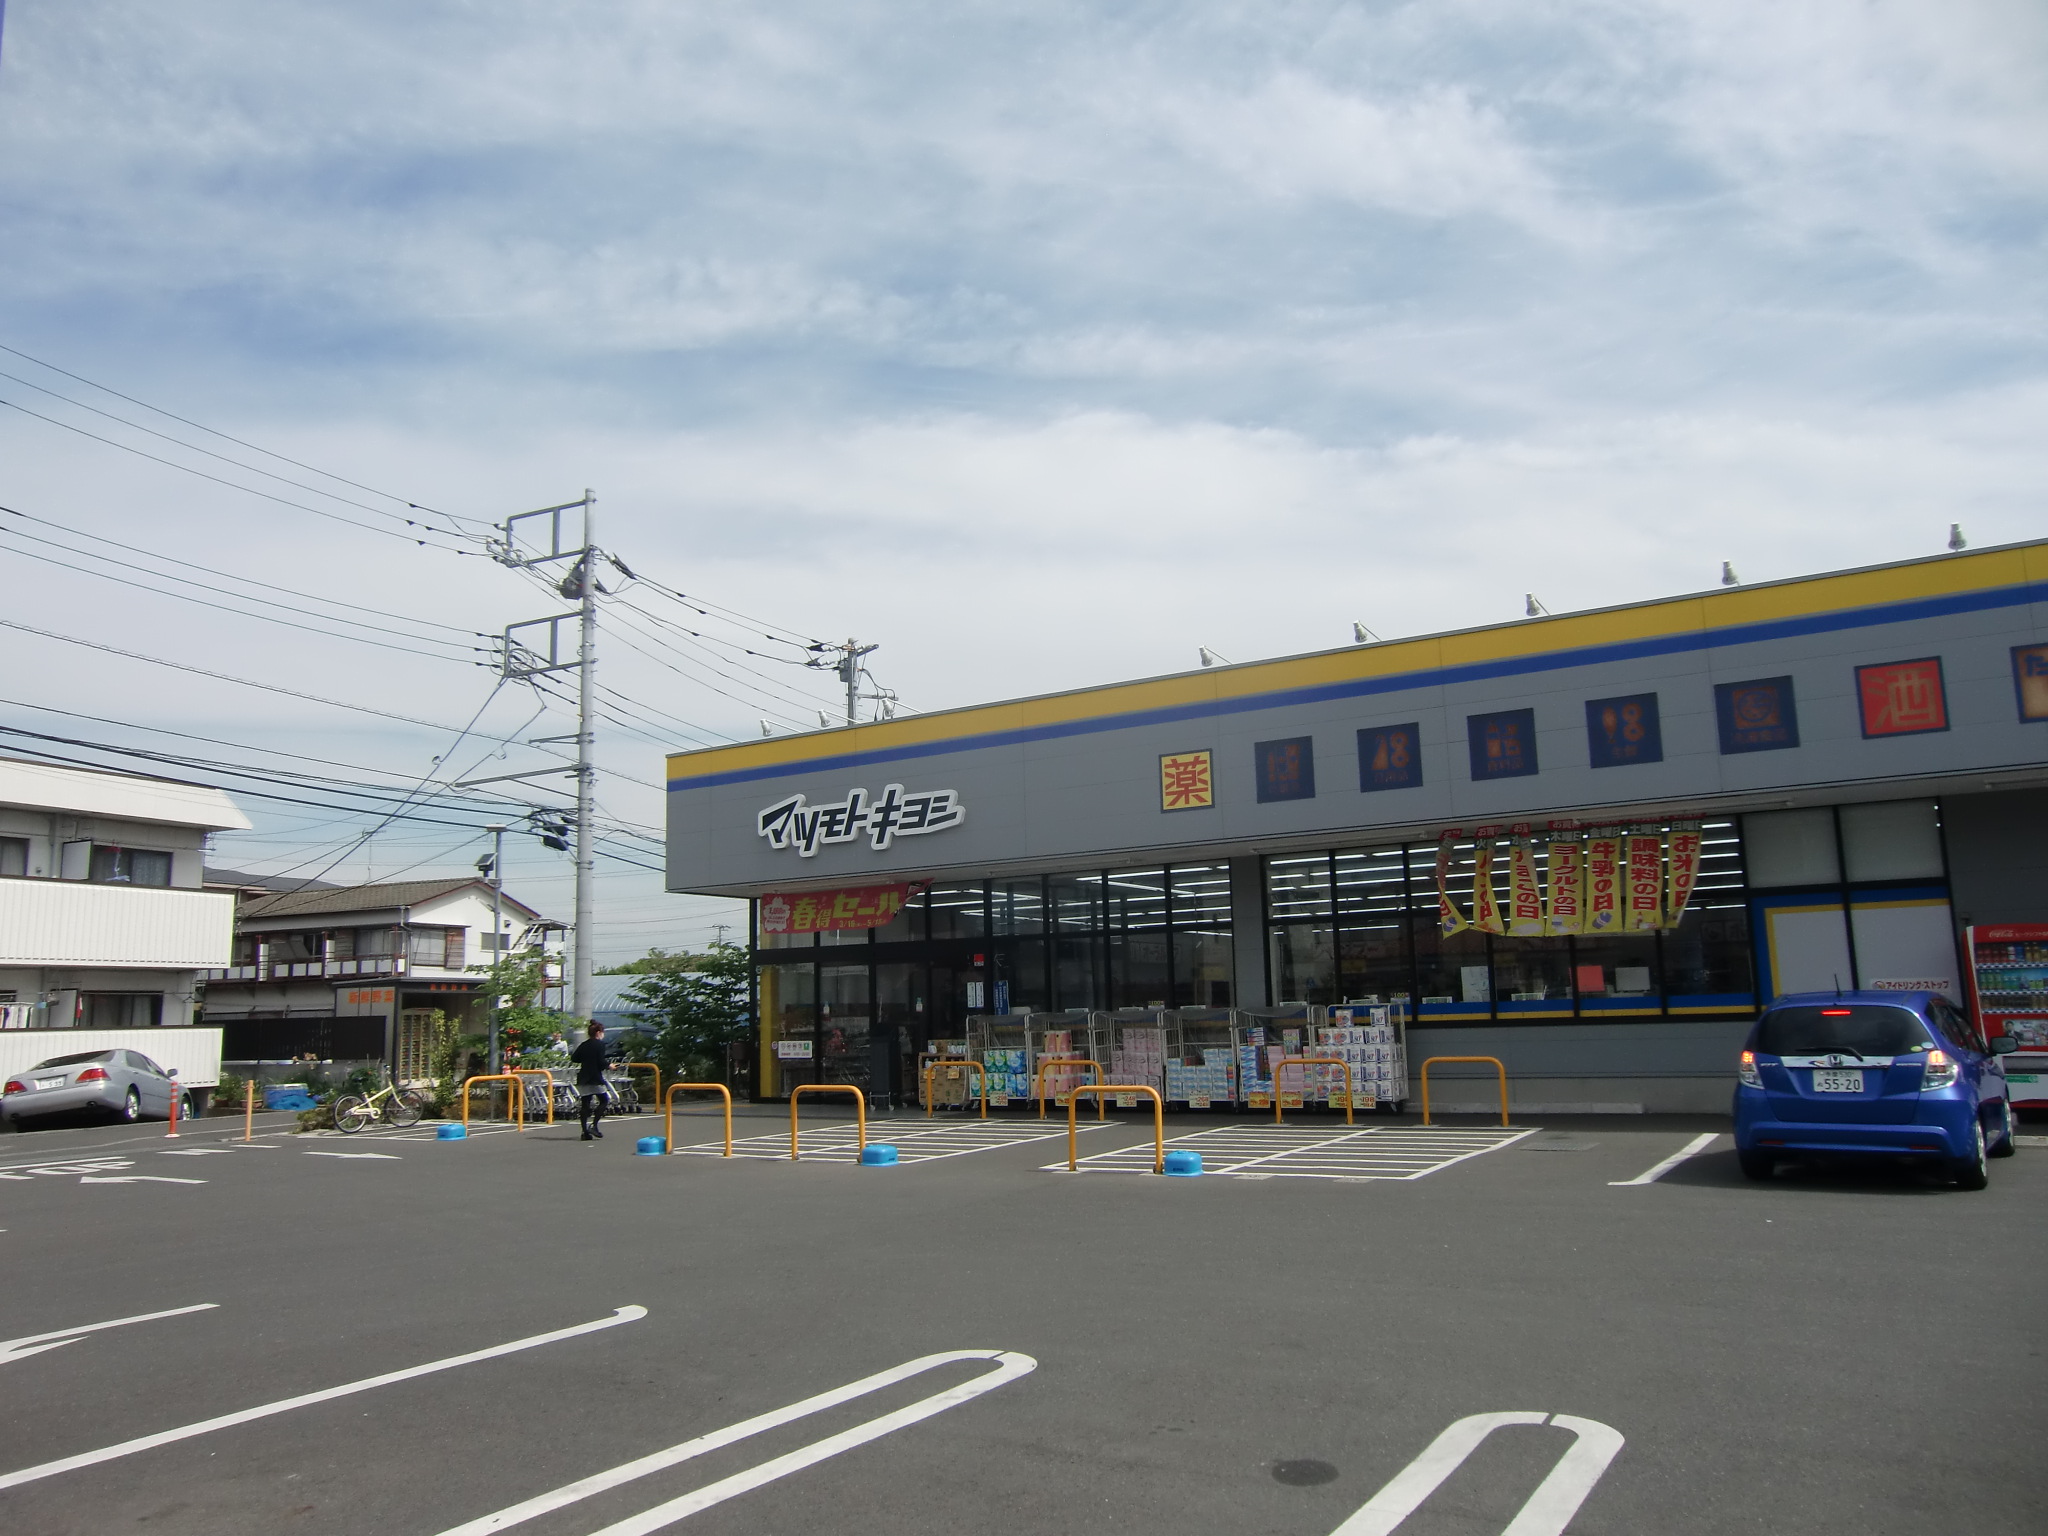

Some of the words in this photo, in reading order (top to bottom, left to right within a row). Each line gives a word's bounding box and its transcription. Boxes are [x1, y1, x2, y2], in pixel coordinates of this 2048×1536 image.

[1864, 667, 1937, 728] 酒
[1164, 755, 1210, 807] 薬
[759, 785, 963, 855] マツモトキヨシ
[1550, 830, 1582, 842] 木曜日
[1589, 826, 1621, 838] 金曜日
[1629, 823, 1661, 835] 土曜日
[1591, 841, 1616, 912] 牛乳の日
[1631, 837, 1660, 911] 調味料の日
[791, 890, 900, 931] 春得セール
[1824, 1078, 1861, 1090] 55-20
